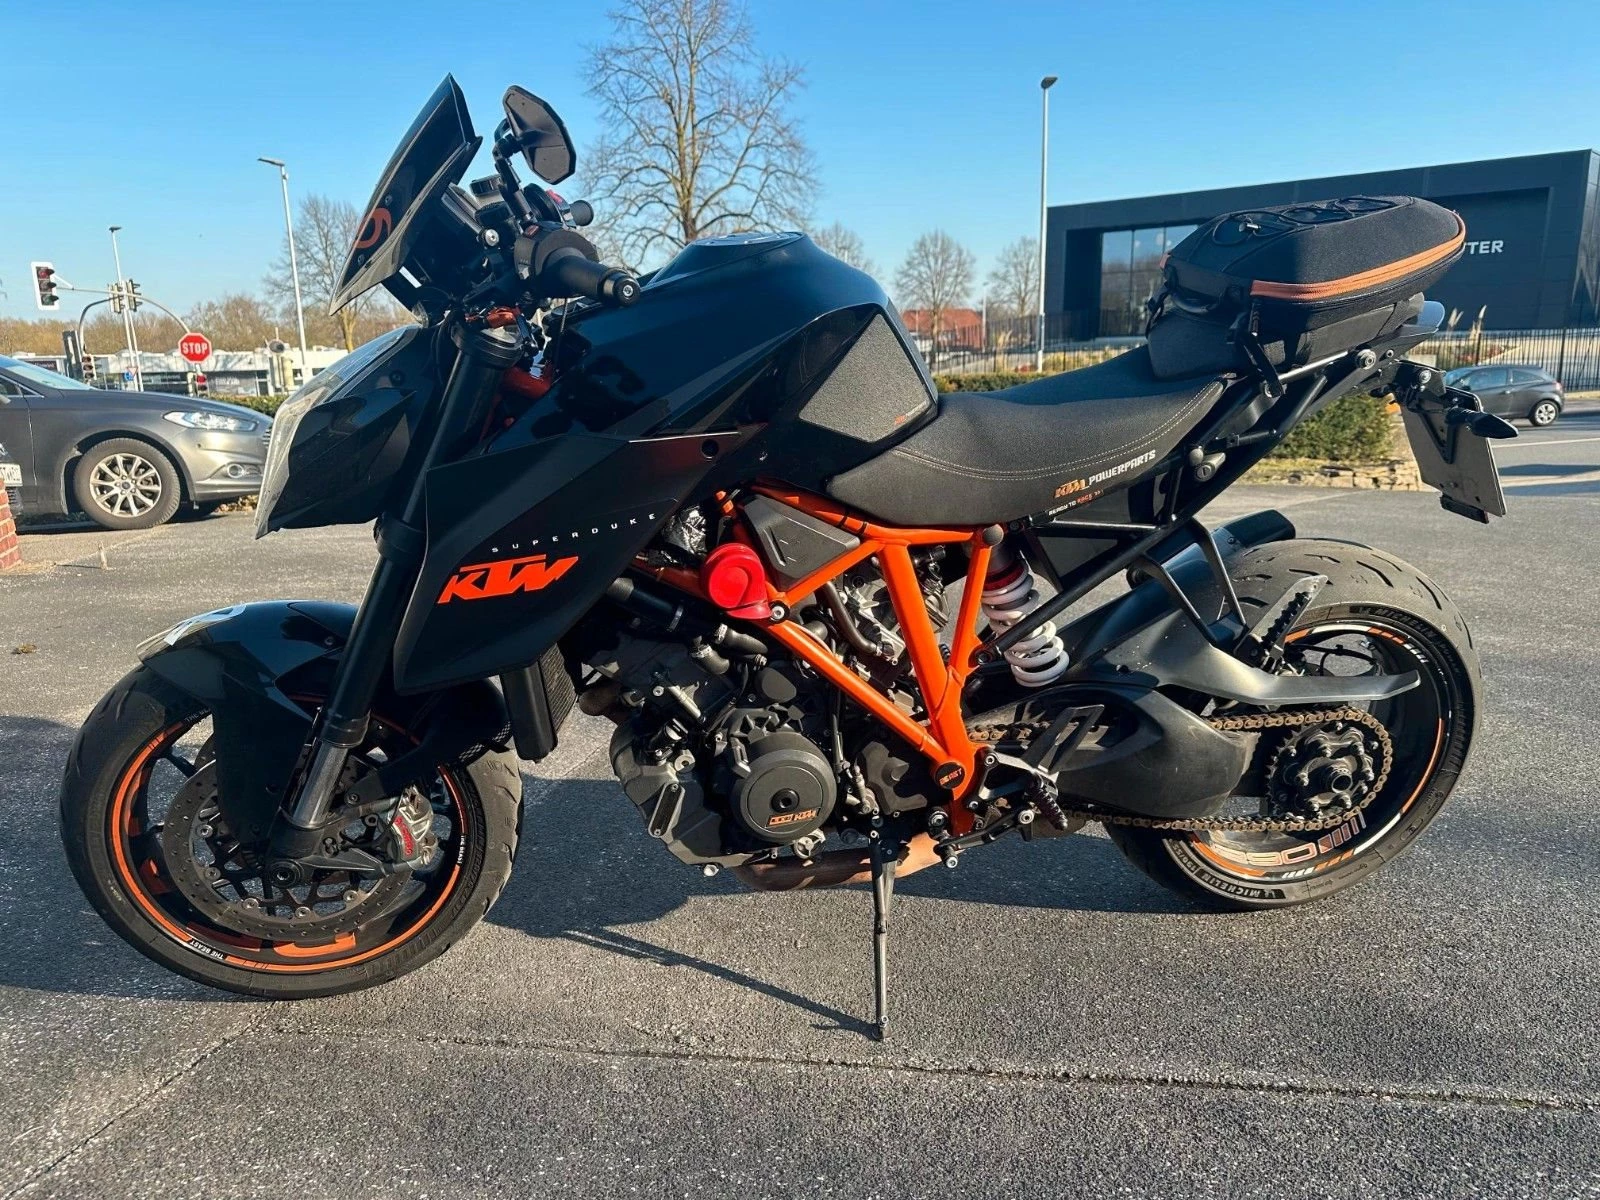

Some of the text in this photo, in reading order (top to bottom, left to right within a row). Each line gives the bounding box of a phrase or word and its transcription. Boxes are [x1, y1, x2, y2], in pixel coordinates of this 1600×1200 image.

[182, 342, 208, 354] STOP
[1088, 449, 1156, 486] POWERPARTS
[437, 553, 579, 604] KTM
[939, 767, 962, 785] BEAST
[1202, 871, 1260, 898] MICHELIN
[189, 939, 224, 960] THE BEAST
